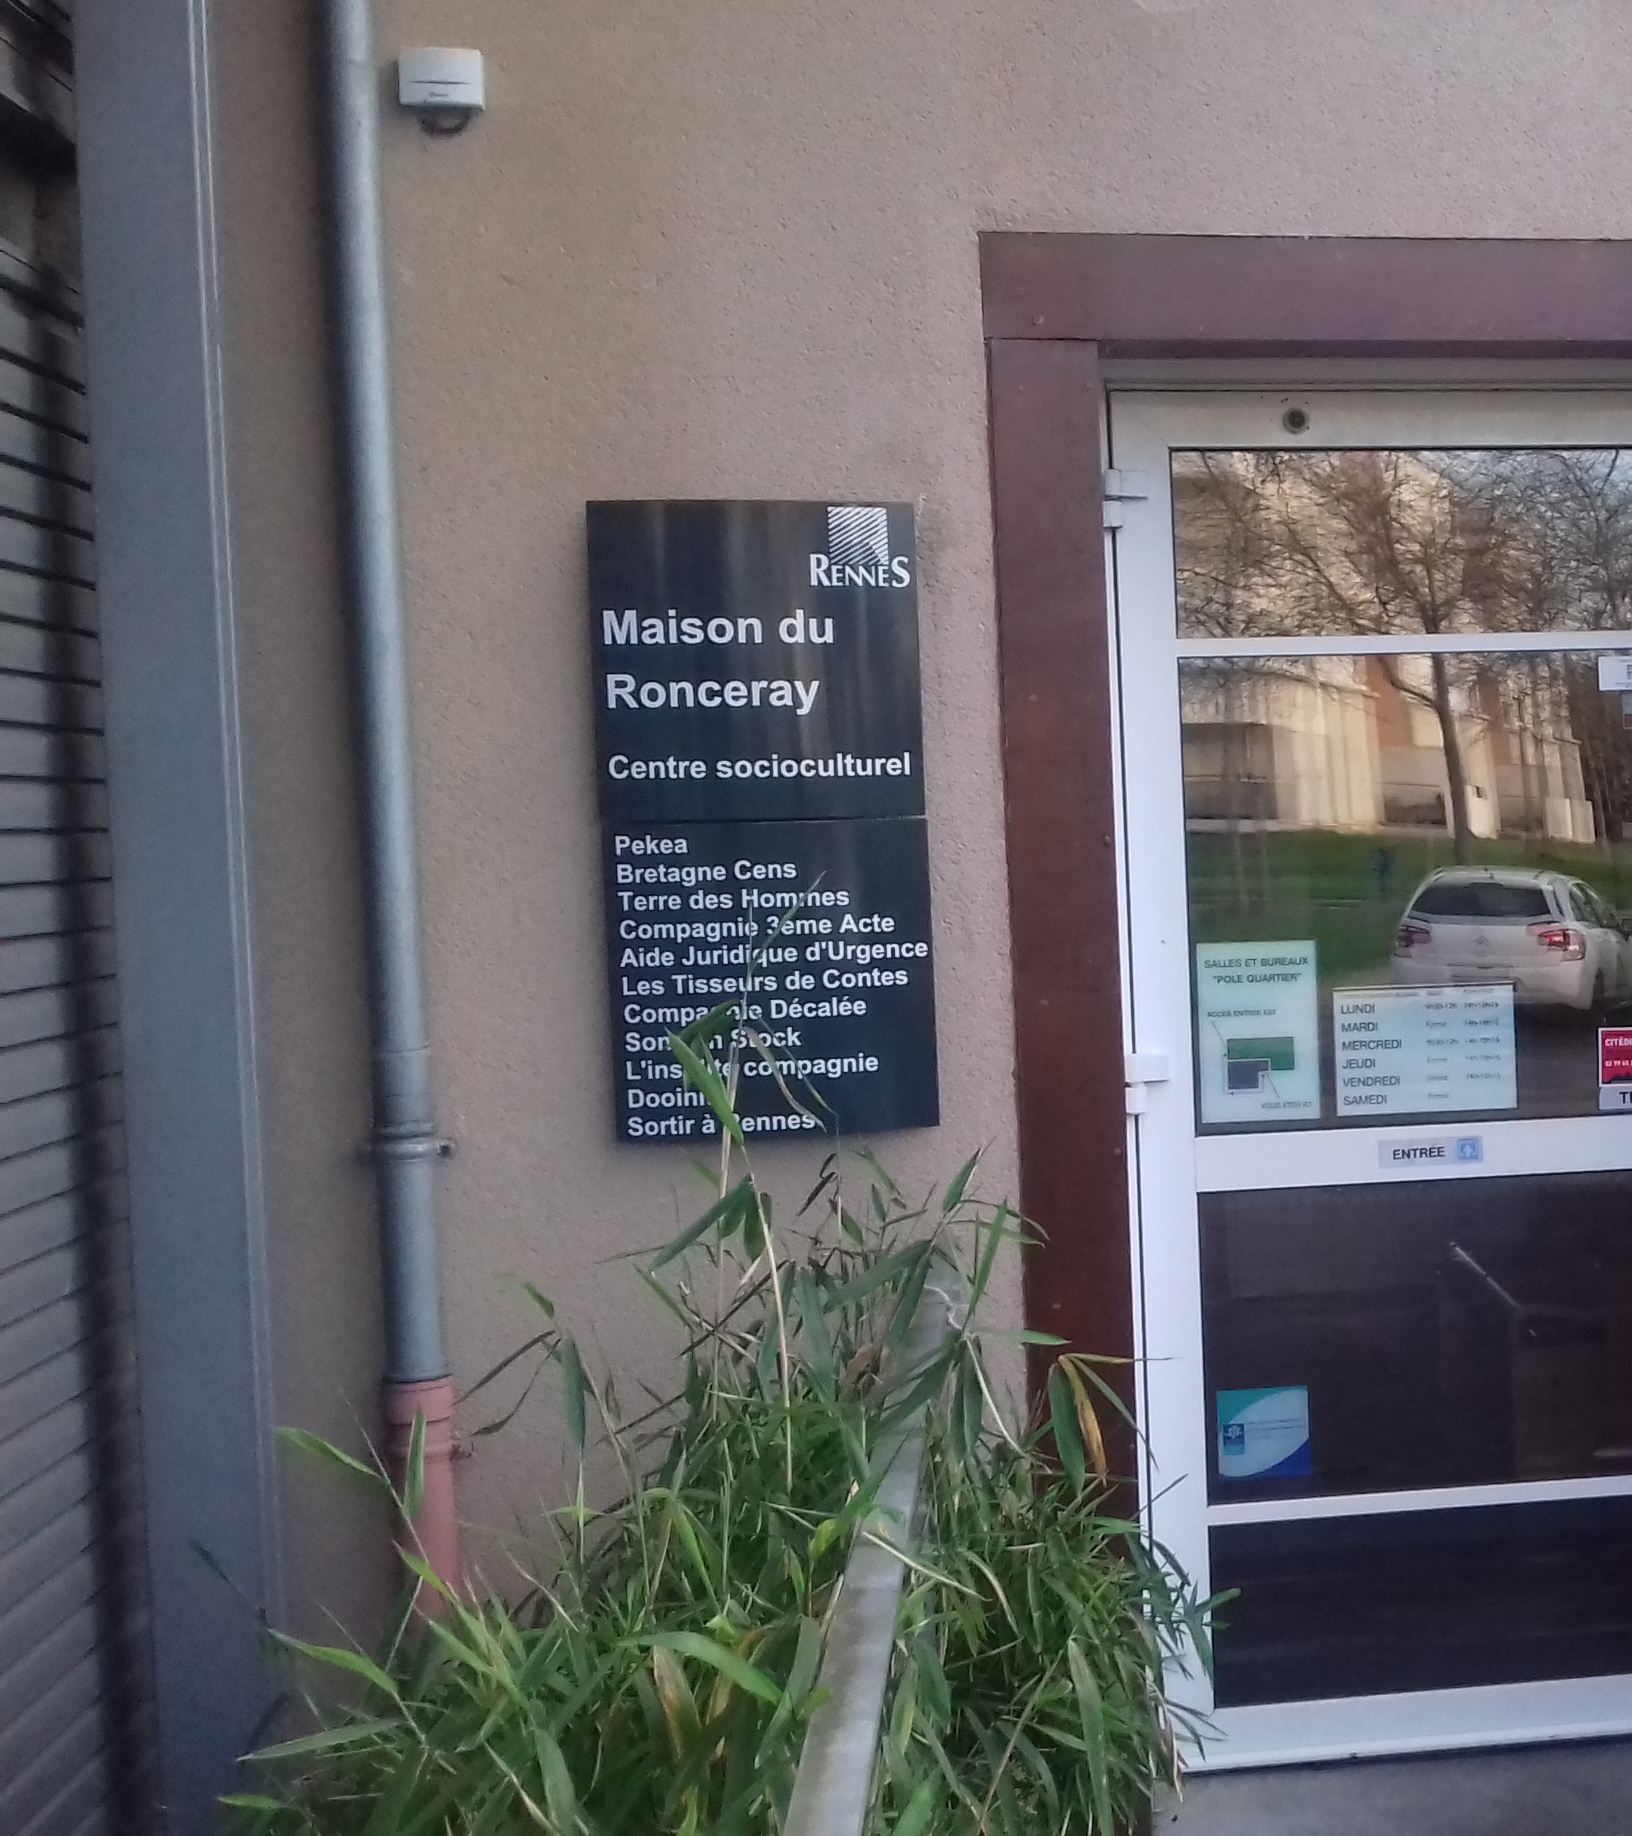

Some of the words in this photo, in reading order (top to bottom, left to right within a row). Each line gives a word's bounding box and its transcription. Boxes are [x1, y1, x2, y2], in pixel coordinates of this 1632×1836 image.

[809, 553, 911, 588] RENNES
[602, 608, 763, 646] Maison
[778, 608, 834, 645] du
[605, 672, 820, 716] Ronceray
[608, 753, 707, 780] Centre
[716, 751, 911, 779] socioculturel
[614, 835, 688, 857] Pekea
[616, 863, 726, 887] Bretagne
[733, 860, 797, 880] Cens
[617, 890, 682, 912] Terre
[689, 889, 733, 910] des
[741, 888, 850, 909] Hommes
[619, 916, 758, 943] Compagnie
[839, 912, 895, 934] Acte
[619, 946, 675, 968] Aide
[682, 943, 798, 968] Juridique
[805, 939, 929, 964] d'Urgence
[1204, 958, 1242, 969] SALLES
[1244, 958, 1257, 968] ET
[1260, 956, 1309, 967] BUREAUX
[621, 976, 665, 997] Les
[671, 973, 778, 995] Tisseurs
[785, 970, 816, 991] de
[823, 967, 909, 990] Contes
[624, 1001, 762, 1027] Companie
[770, 996, 868, 1020] Décalée
[1340, 1003, 1375, 1015] LUNDI
[1341, 1021, 1378, 1033] MARDI
[625, 1032, 683, 1052] Son
[1341, 1039, 1402, 1051] MERCREDI
[743, 1053, 879, 1080] compagnie
[1342, 1058, 1376, 1069] JEUDI
[1343, 1076, 1401, 1087] VENDREDI
[1343, 1094, 1388, 1106] SAMEDI
[627, 1115, 695, 1137] Sortir
[702, 1113, 717, 1135] à
[727, 1112, 816, 1134] ennes
[1392, 1144, 1445, 1160] ENTRÉE
